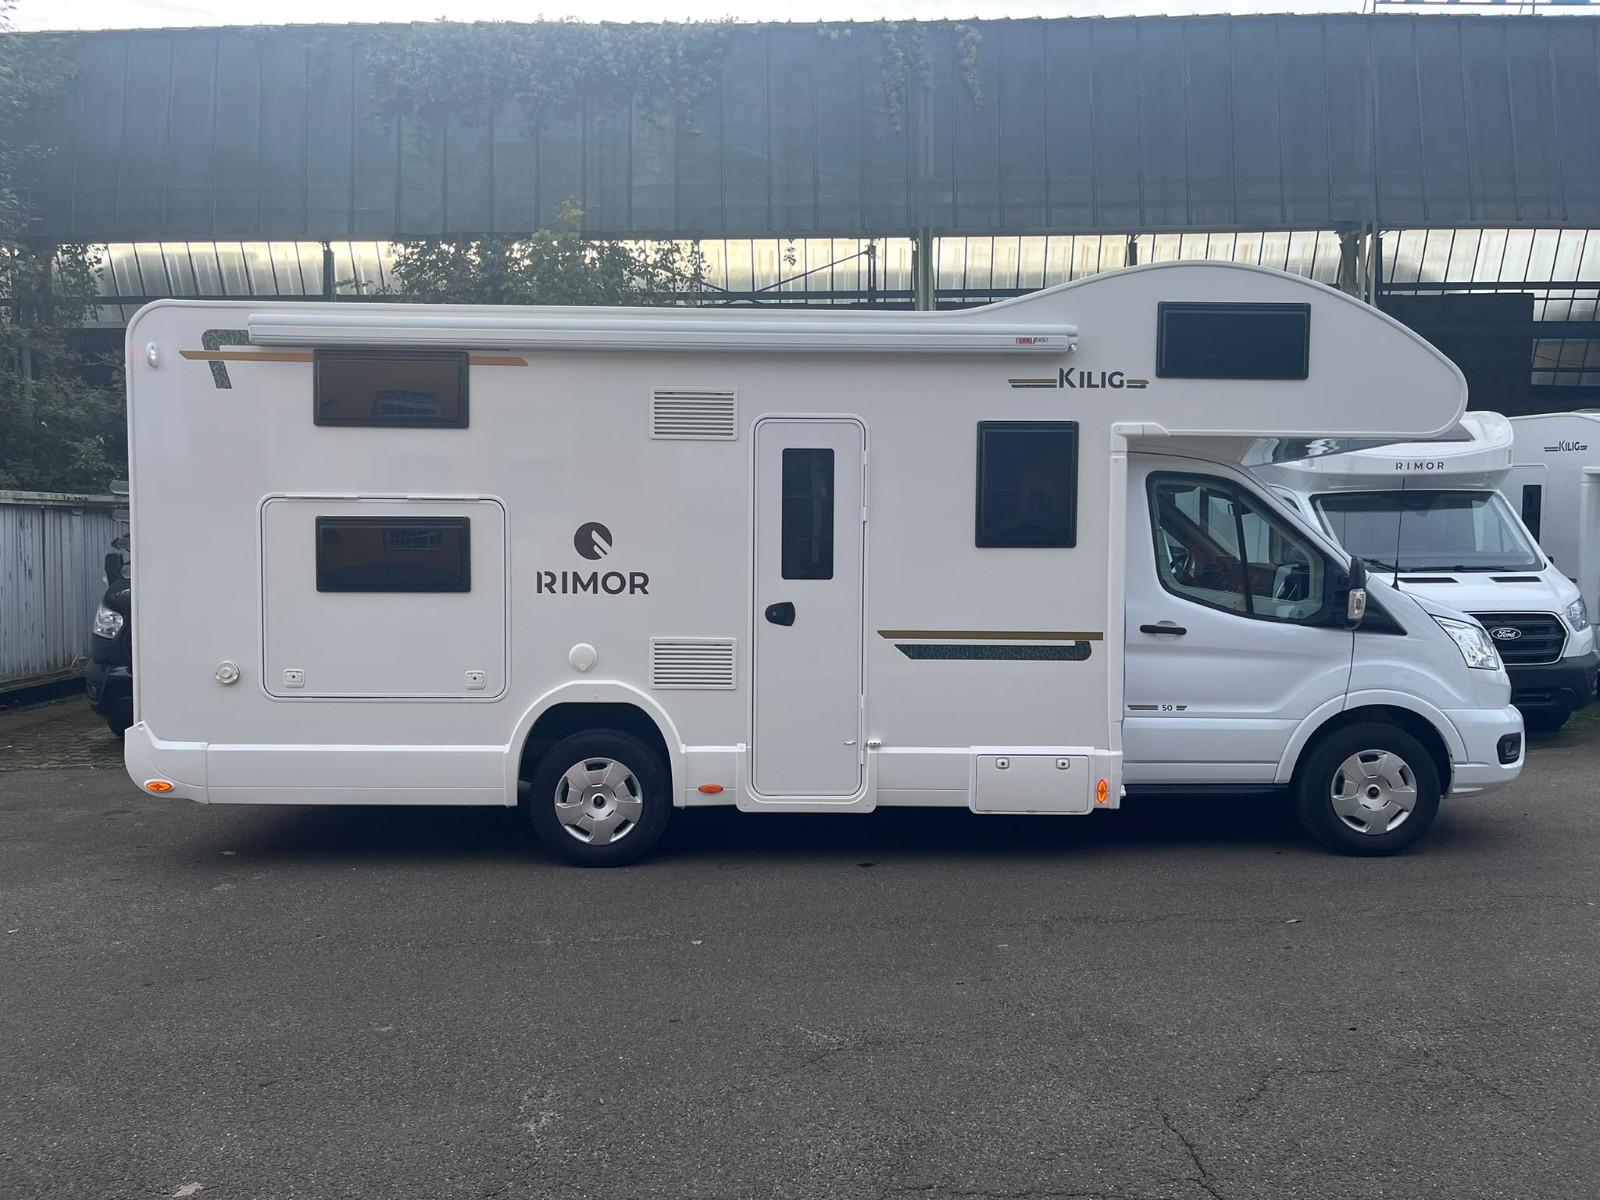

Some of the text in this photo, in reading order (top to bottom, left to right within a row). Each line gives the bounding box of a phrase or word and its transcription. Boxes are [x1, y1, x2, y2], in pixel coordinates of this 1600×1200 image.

[1059, 368, 1124, 388] KILIG
[1559, 440, 1580, 451] KILIG
[1396, 461, 1445, 470] RIMOR
[536, 570, 650, 595] RIMOR
[1497, 630, 1516, 638] Ford
[1162, 704, 1173, 712] 50
